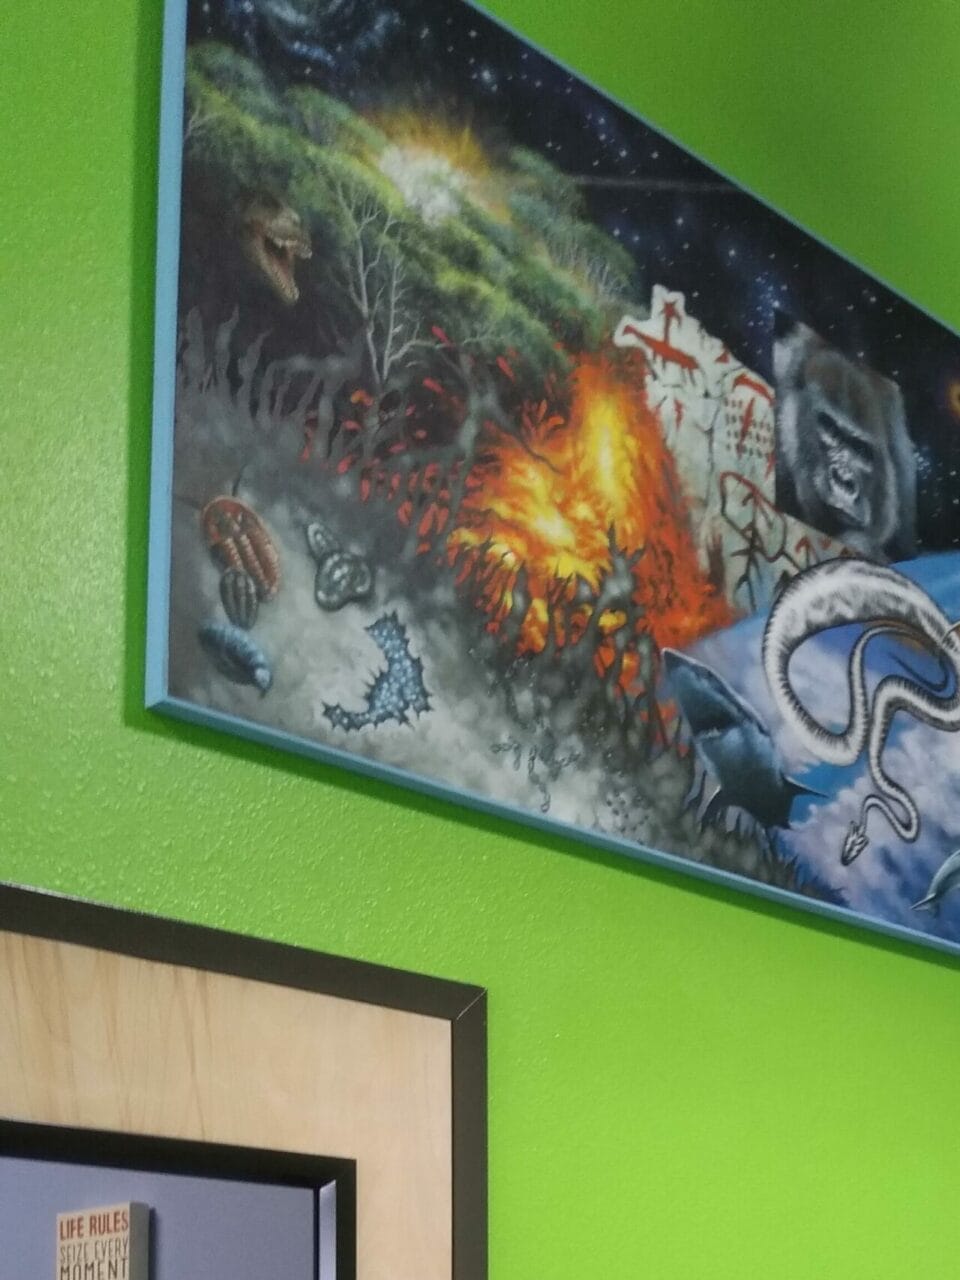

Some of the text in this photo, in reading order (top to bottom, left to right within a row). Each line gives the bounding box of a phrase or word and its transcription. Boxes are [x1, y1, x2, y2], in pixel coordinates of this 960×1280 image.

[60, 1211, 128, 1240] LIFE RULES
[61, 1237, 128, 1265] SEIZE EVERY
